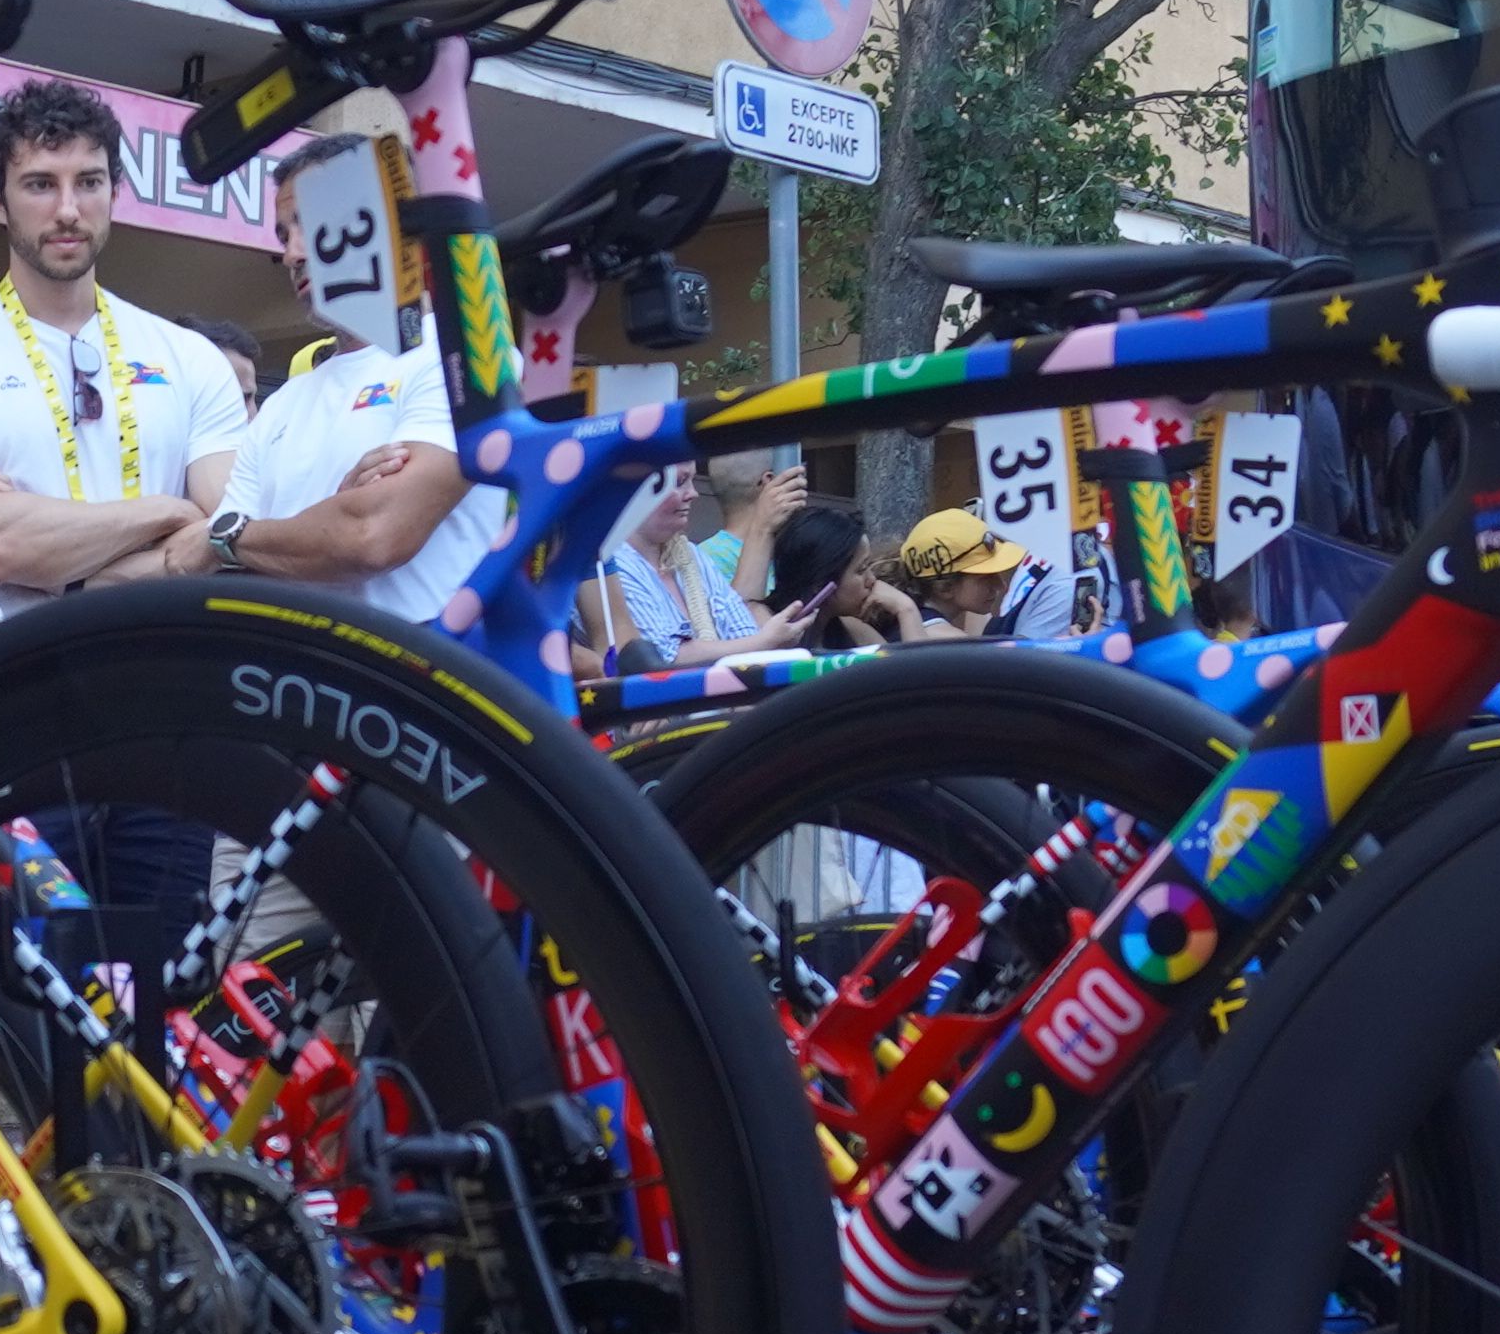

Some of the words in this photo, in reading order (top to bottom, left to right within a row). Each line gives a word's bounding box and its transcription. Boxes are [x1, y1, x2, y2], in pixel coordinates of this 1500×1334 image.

[788, 123, 860, 157] 2790-NKF
[791, 98, 856, 131] EXCEPTE
[314, 209, 383, 301] 37
[987, 437, 1056, 526] 35
[1228, 453, 1288, 528] 34
[231, 663, 489, 805] AEOLUS
